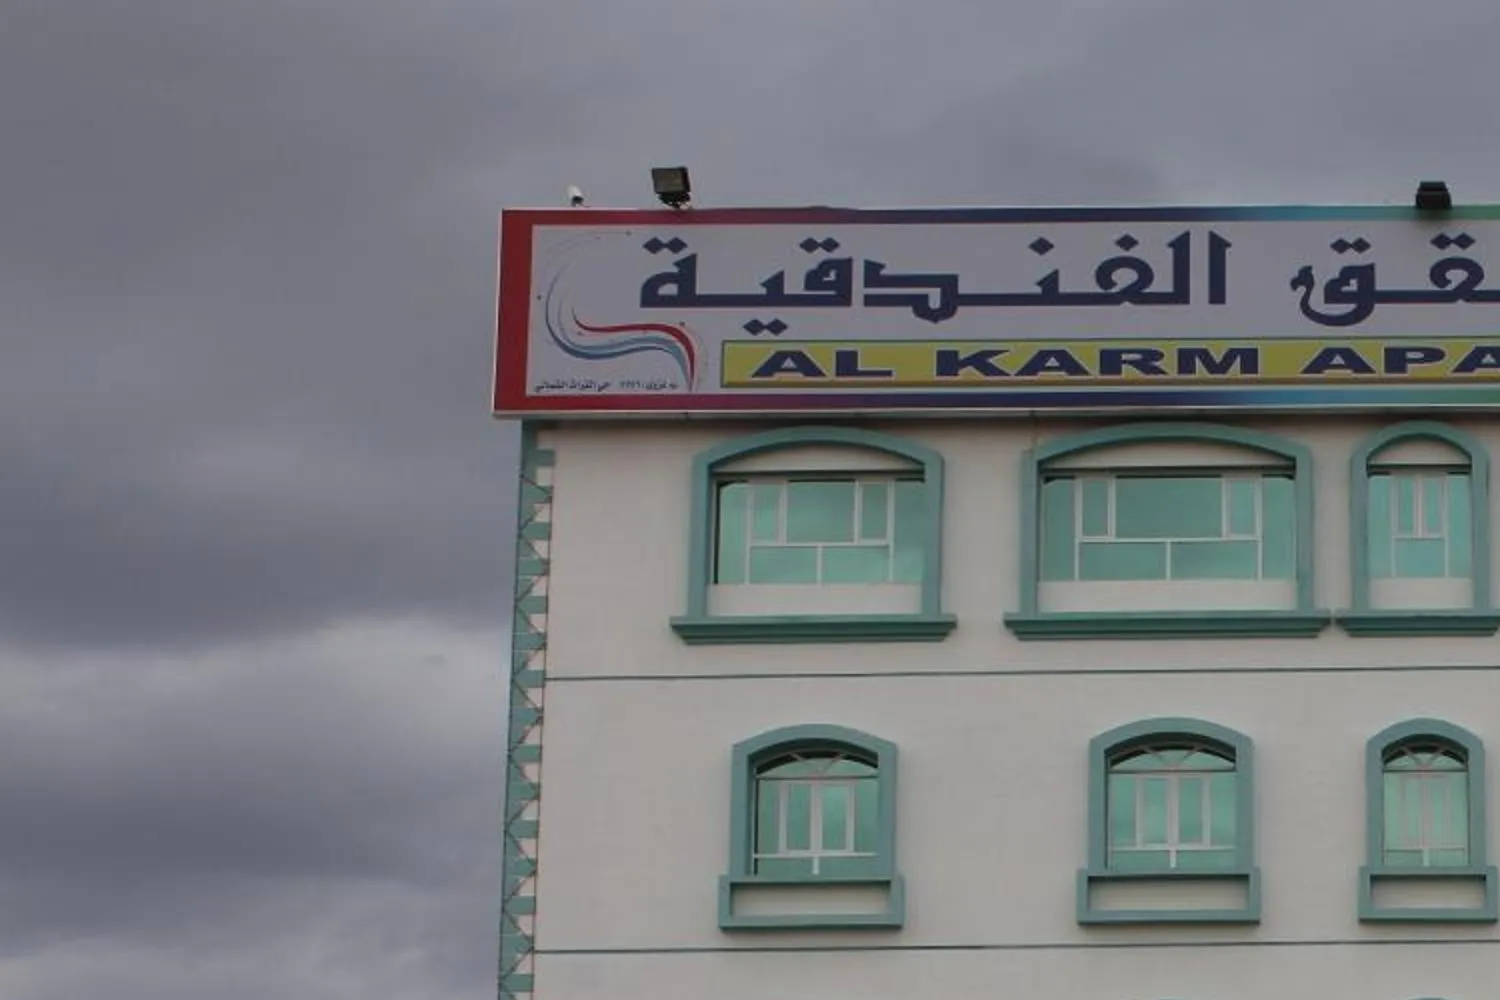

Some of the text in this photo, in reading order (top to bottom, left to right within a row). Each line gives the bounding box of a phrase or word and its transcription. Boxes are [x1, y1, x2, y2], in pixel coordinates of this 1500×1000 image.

[639, 230, 1232, 337] الفندقية
[751, 349, 893, 379] AL
[935, 347, 1260, 377] KARM
